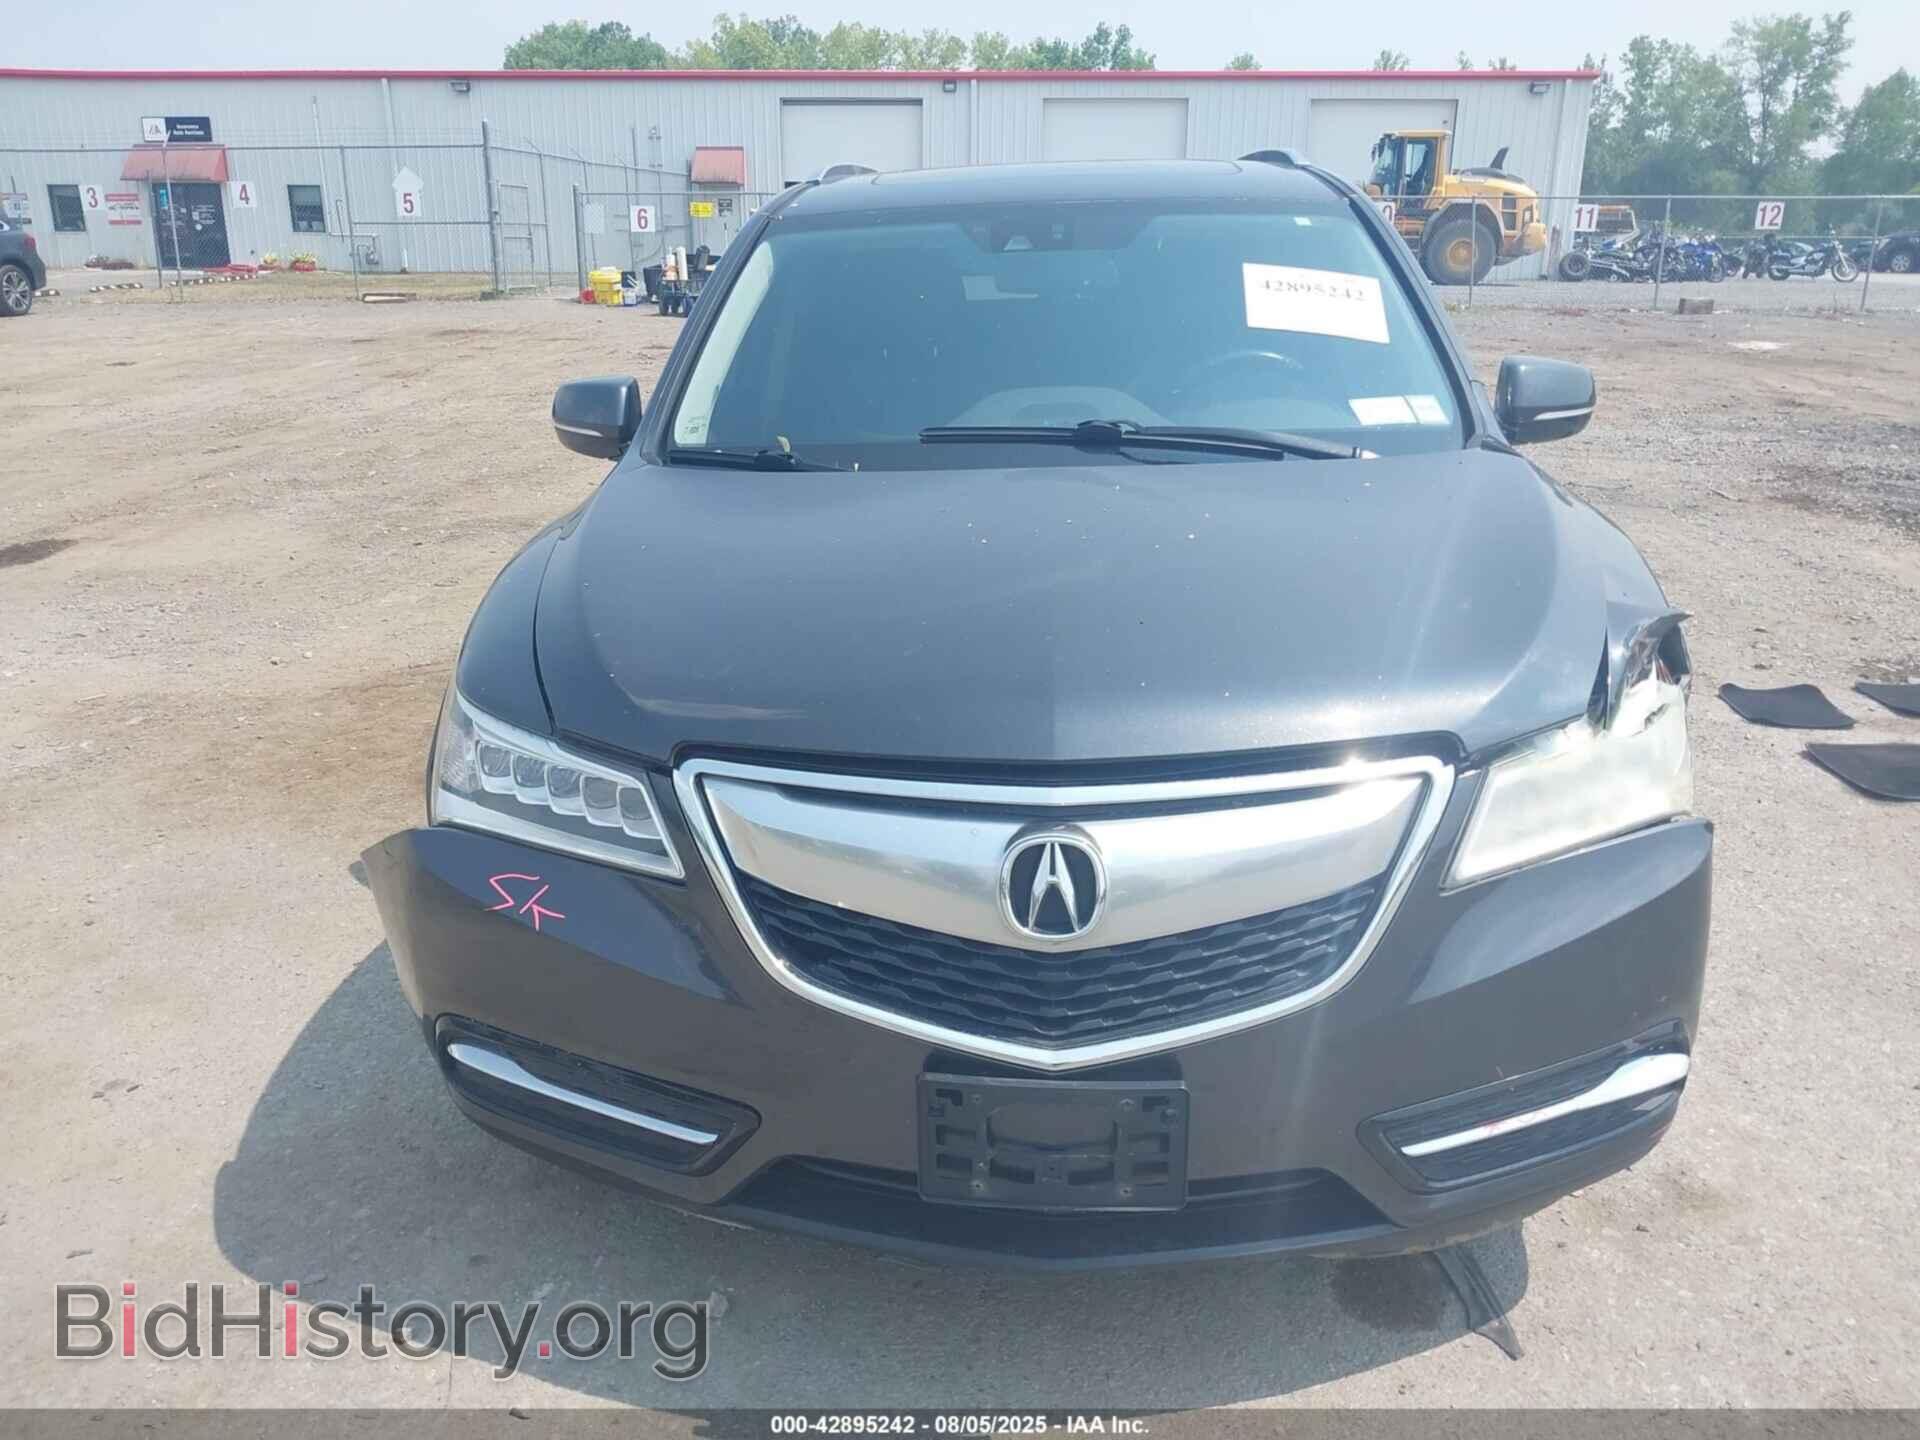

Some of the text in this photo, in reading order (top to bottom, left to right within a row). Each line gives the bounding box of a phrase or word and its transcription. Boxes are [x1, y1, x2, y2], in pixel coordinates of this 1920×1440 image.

[86, 187, 98, 208] 3
[239, 184, 250, 205] 4
[402, 192, 414, 214] 5
[637, 208, 649, 230] 6
[1575, 207, 1596, 229] 11
[1759, 205, 1781, 227] 12
